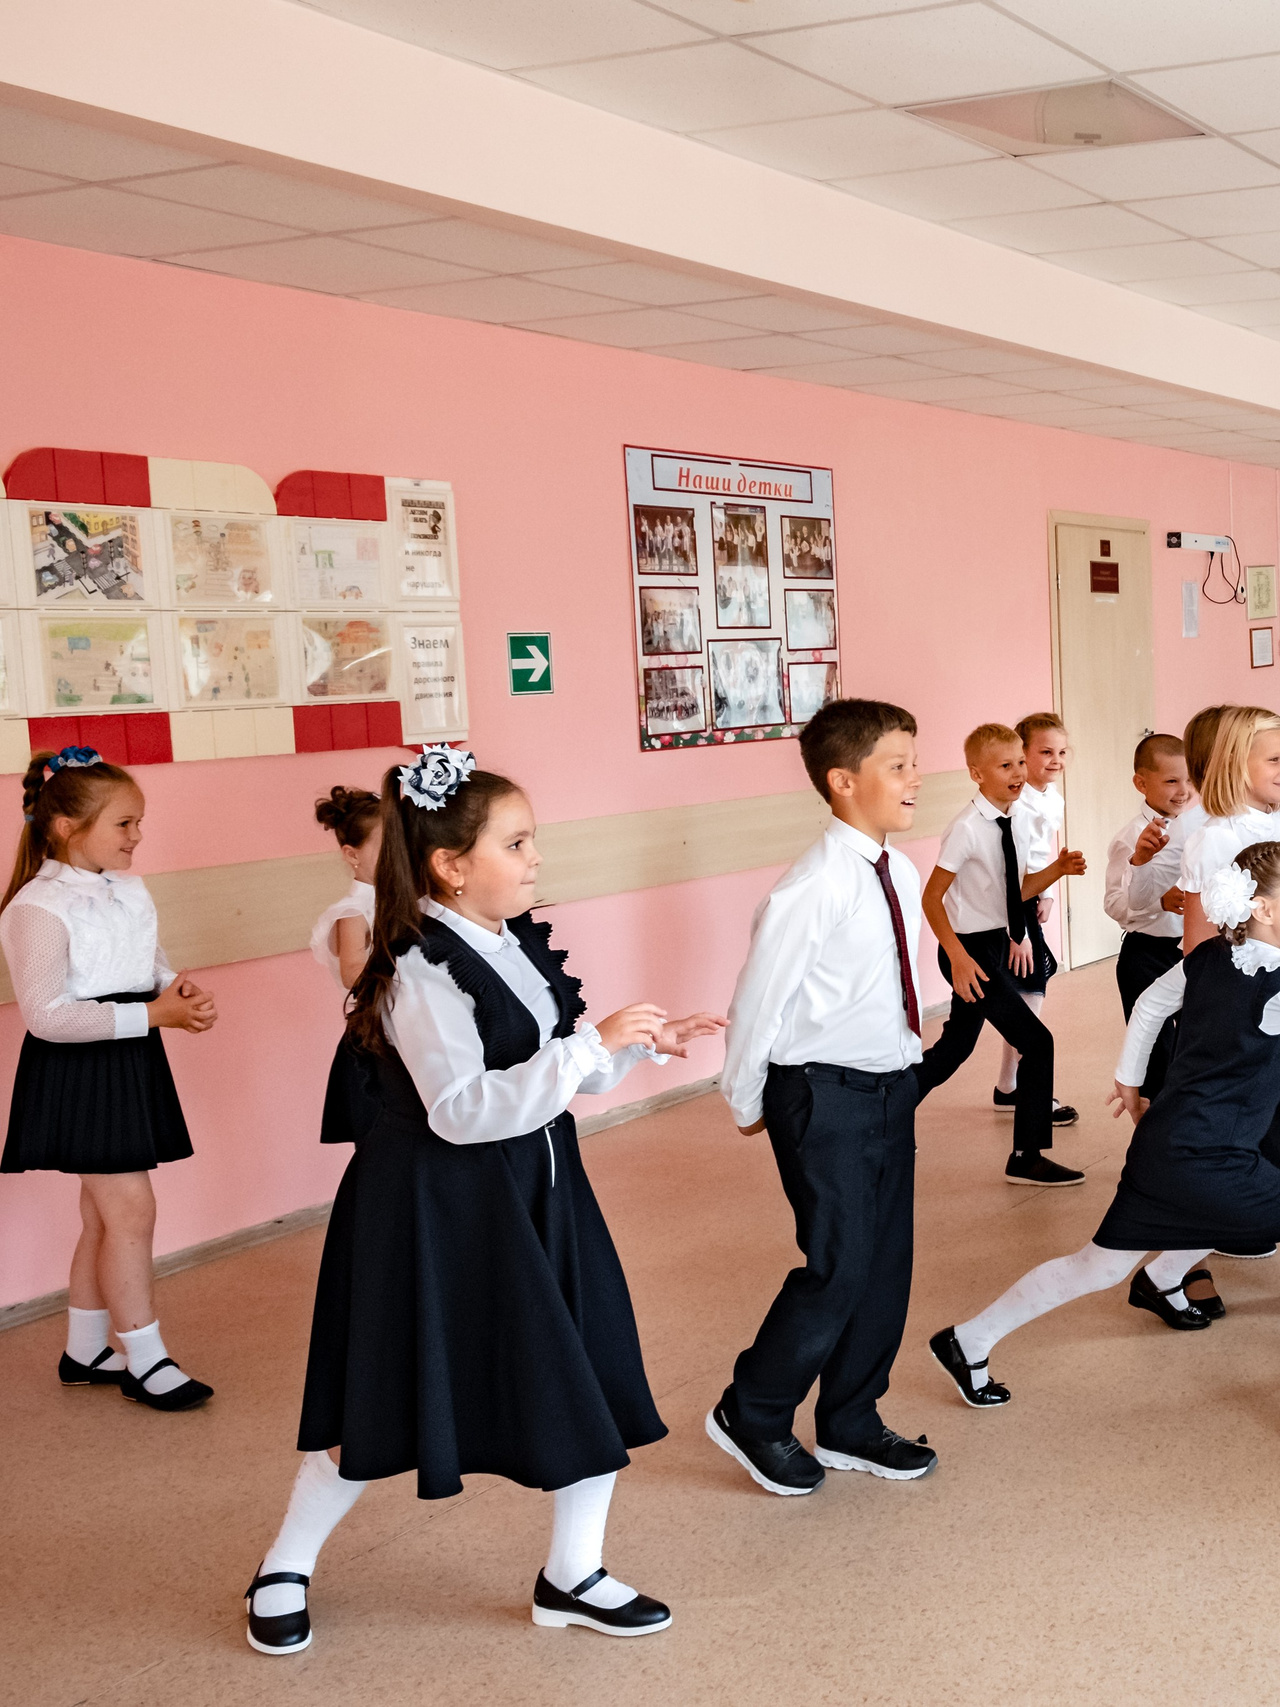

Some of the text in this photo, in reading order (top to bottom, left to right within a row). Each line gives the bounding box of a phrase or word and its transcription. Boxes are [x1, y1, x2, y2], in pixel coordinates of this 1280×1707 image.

[678, 466, 792, 497] Наши детки
[410, 636, 449, 649] Знаем
